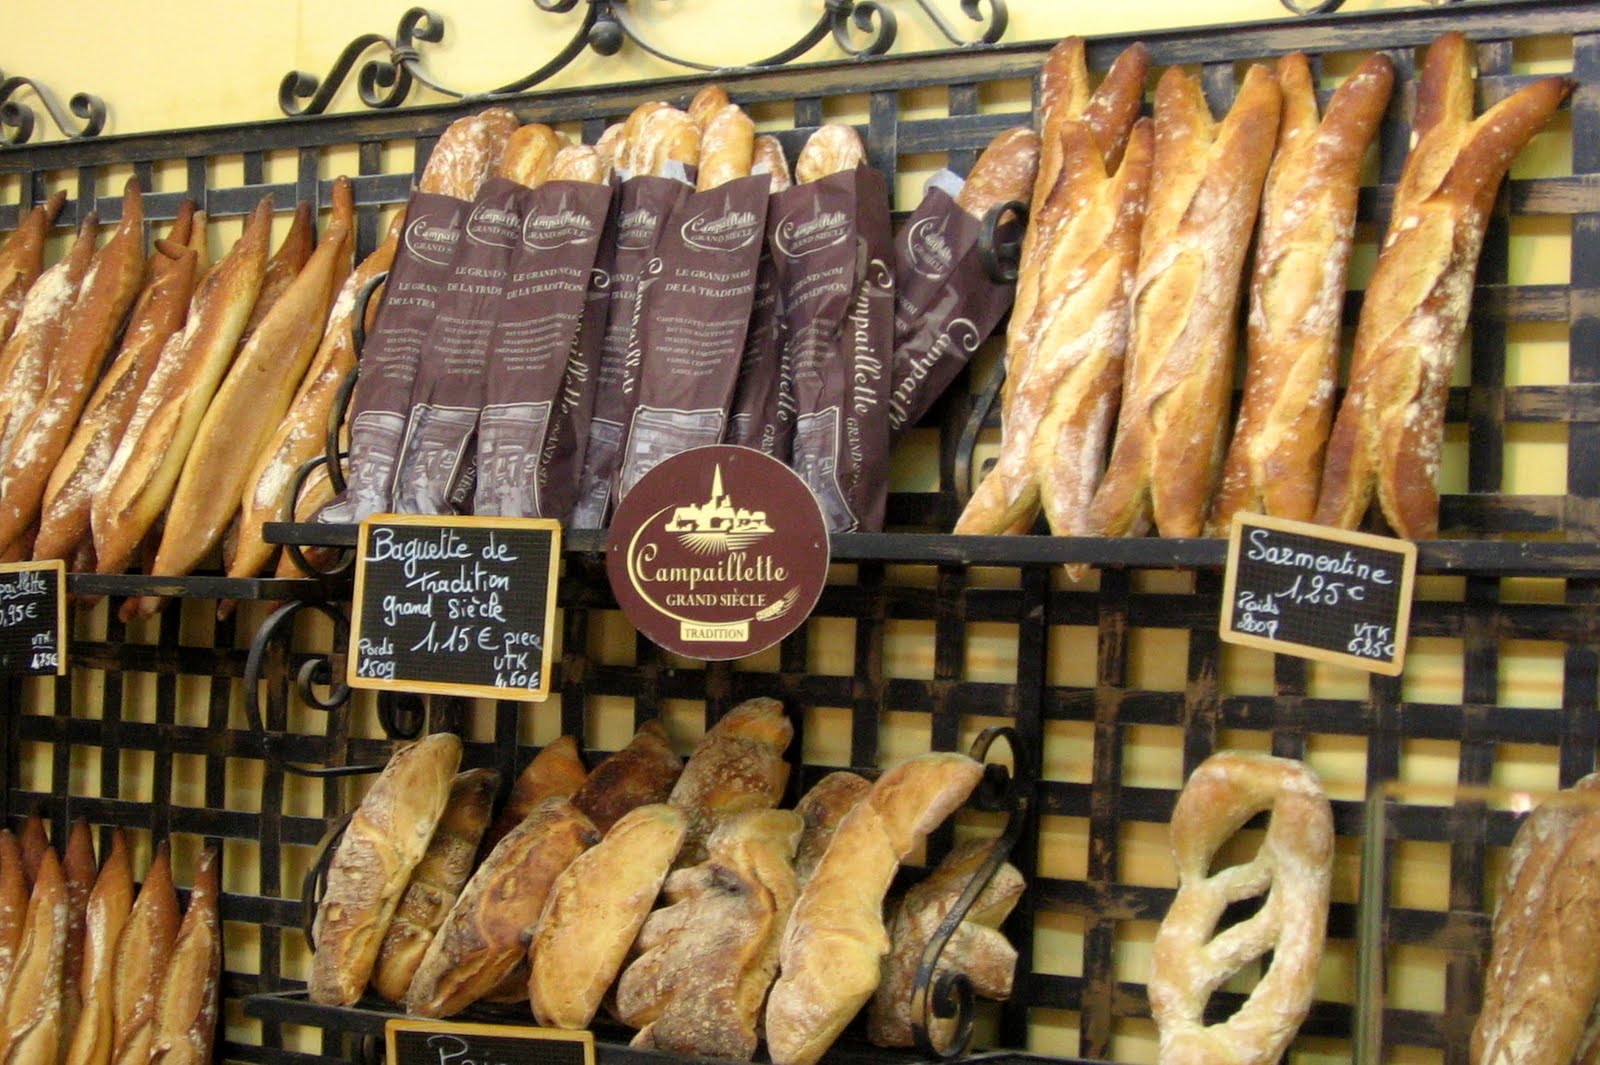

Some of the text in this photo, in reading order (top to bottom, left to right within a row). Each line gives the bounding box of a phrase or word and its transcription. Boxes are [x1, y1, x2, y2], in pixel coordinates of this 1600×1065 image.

[456, 266, 466, 275] LE
[513, 273, 525, 282] LE
[526, 269, 558, 280] GRAND
[675, 268, 689, 277] LE
[690, 270, 730, 282] GRAND
[447, 283, 459, 292] DE
[460, 283, 473, 294] LA
[507, 281, 584, 300] DE LA TRADITION
[665, 283, 681, 292] DE
[682, 284, 697, 294] LA
[848, 258, 893, 416] Campaillette
[363, 528, 518, 578] Baguette de
[636, 543, 788, 591] Campaillette
[666, 587, 767, 608] GRAND SIÈCLE
[684, 627, 744, 640] TRADITION
